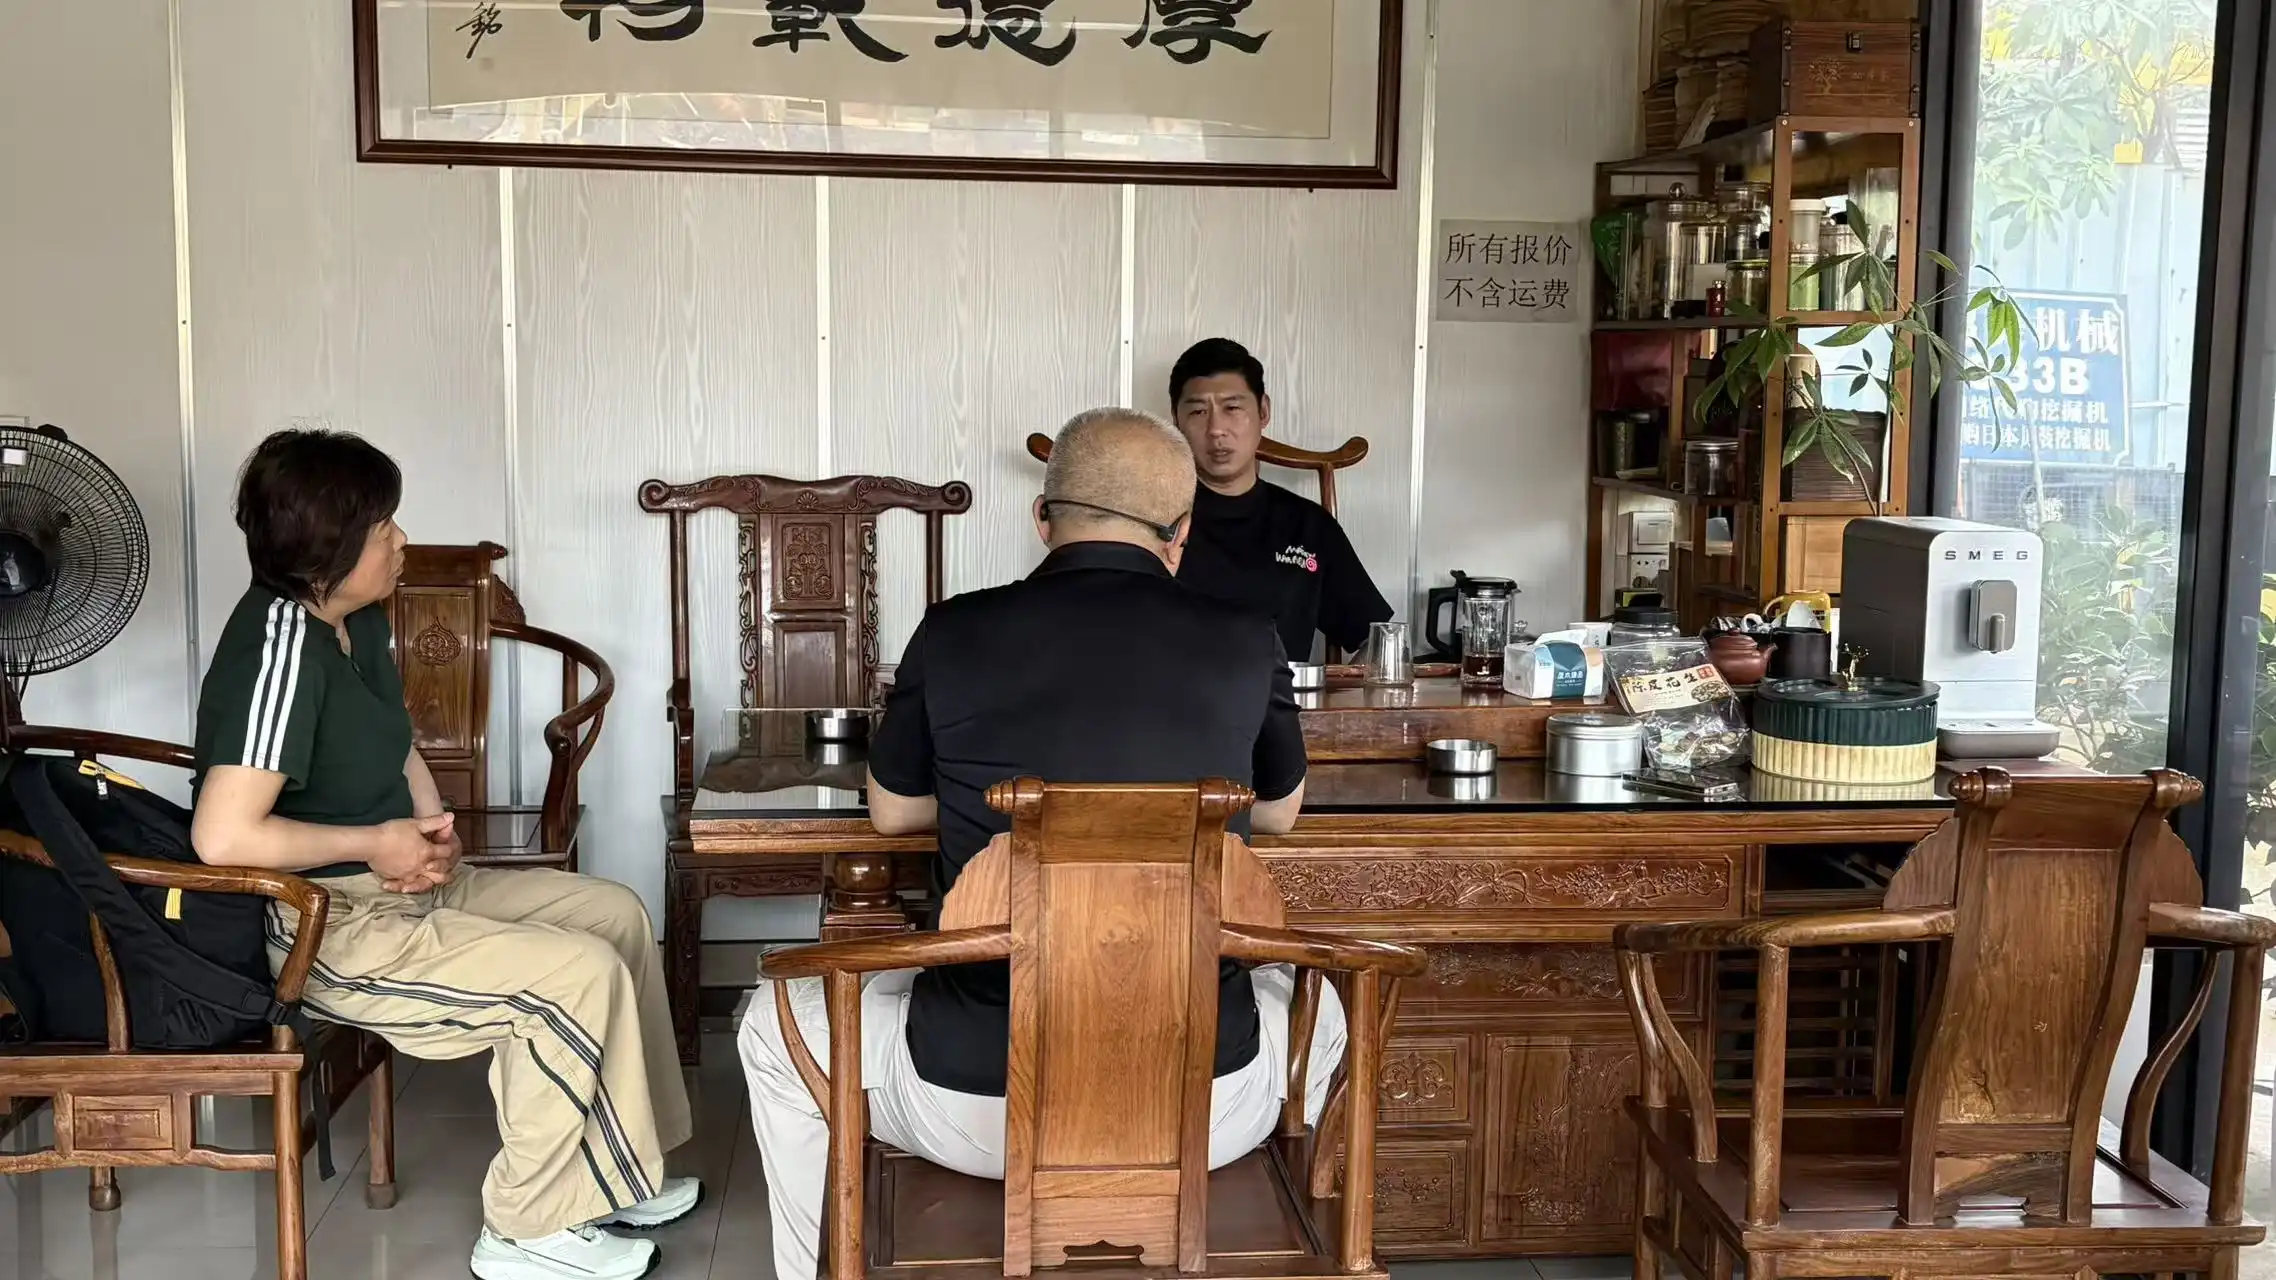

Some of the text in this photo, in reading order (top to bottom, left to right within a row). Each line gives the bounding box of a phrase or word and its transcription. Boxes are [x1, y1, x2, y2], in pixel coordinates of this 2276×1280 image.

[1444, 232, 1573, 267] 所有报价
[1441, 276, 1571, 310] 不含运费
[1944, 550, 2029, 561] SMEG
